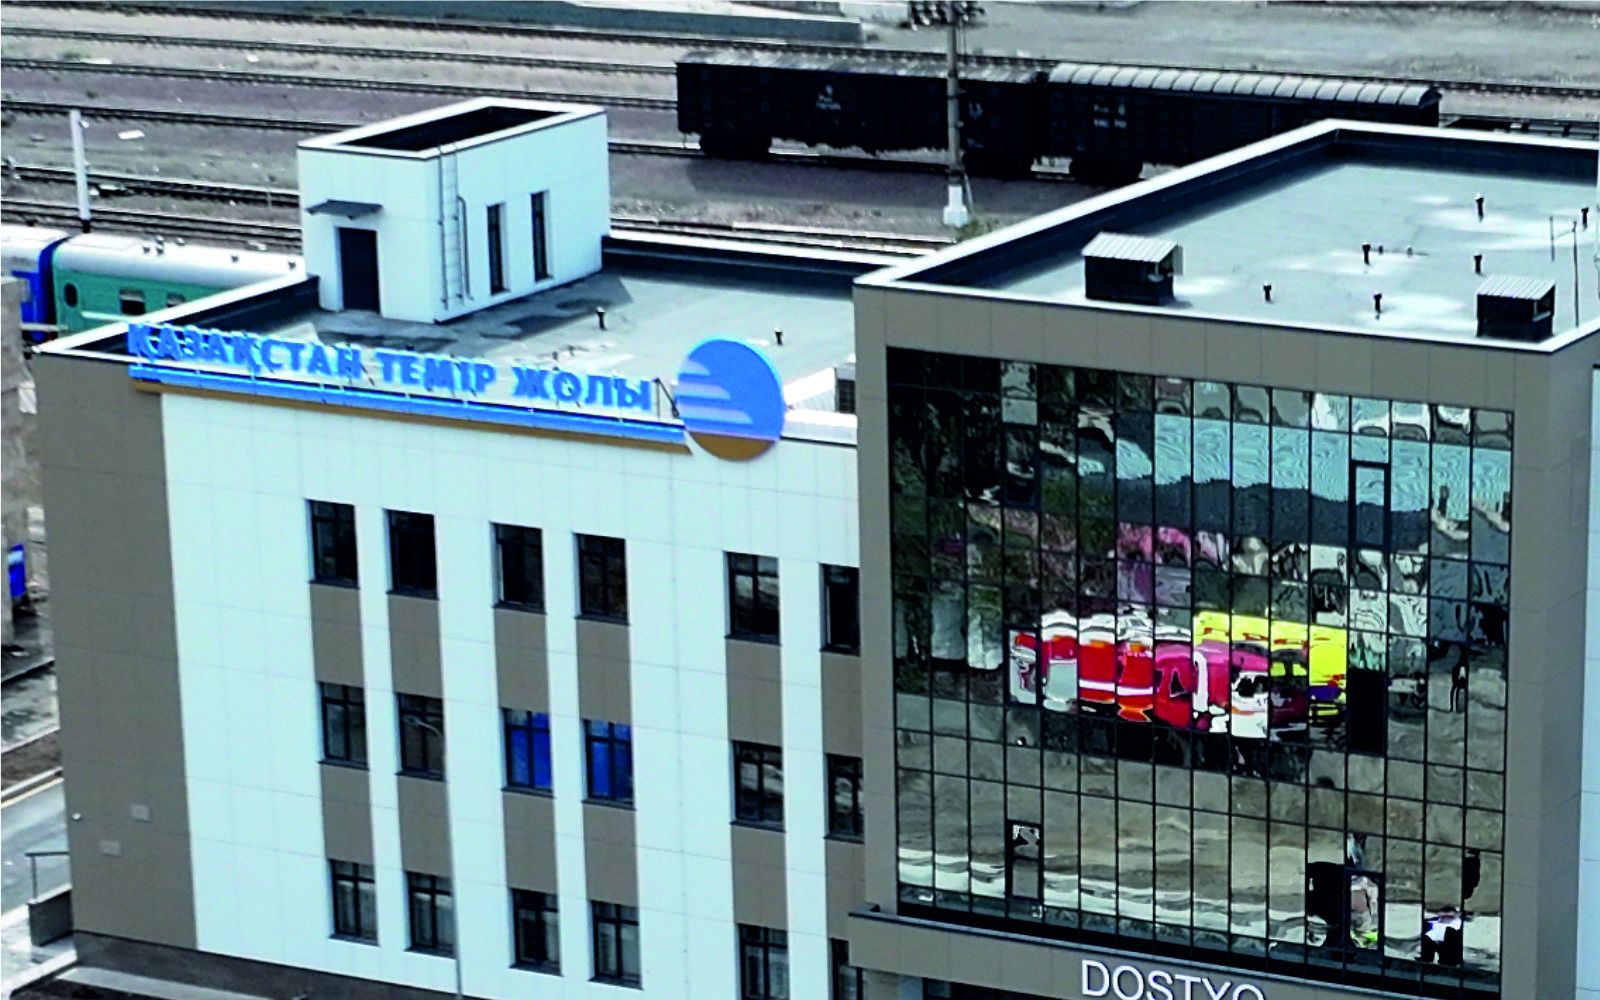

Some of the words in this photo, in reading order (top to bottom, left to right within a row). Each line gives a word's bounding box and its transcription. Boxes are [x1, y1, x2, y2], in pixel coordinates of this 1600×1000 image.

[127, 322, 364, 379] ҚАЗАҚСТАН
[375, 348, 497, 394] ТЕМІР
[511, 363, 653, 411] ЖОЛЫ
